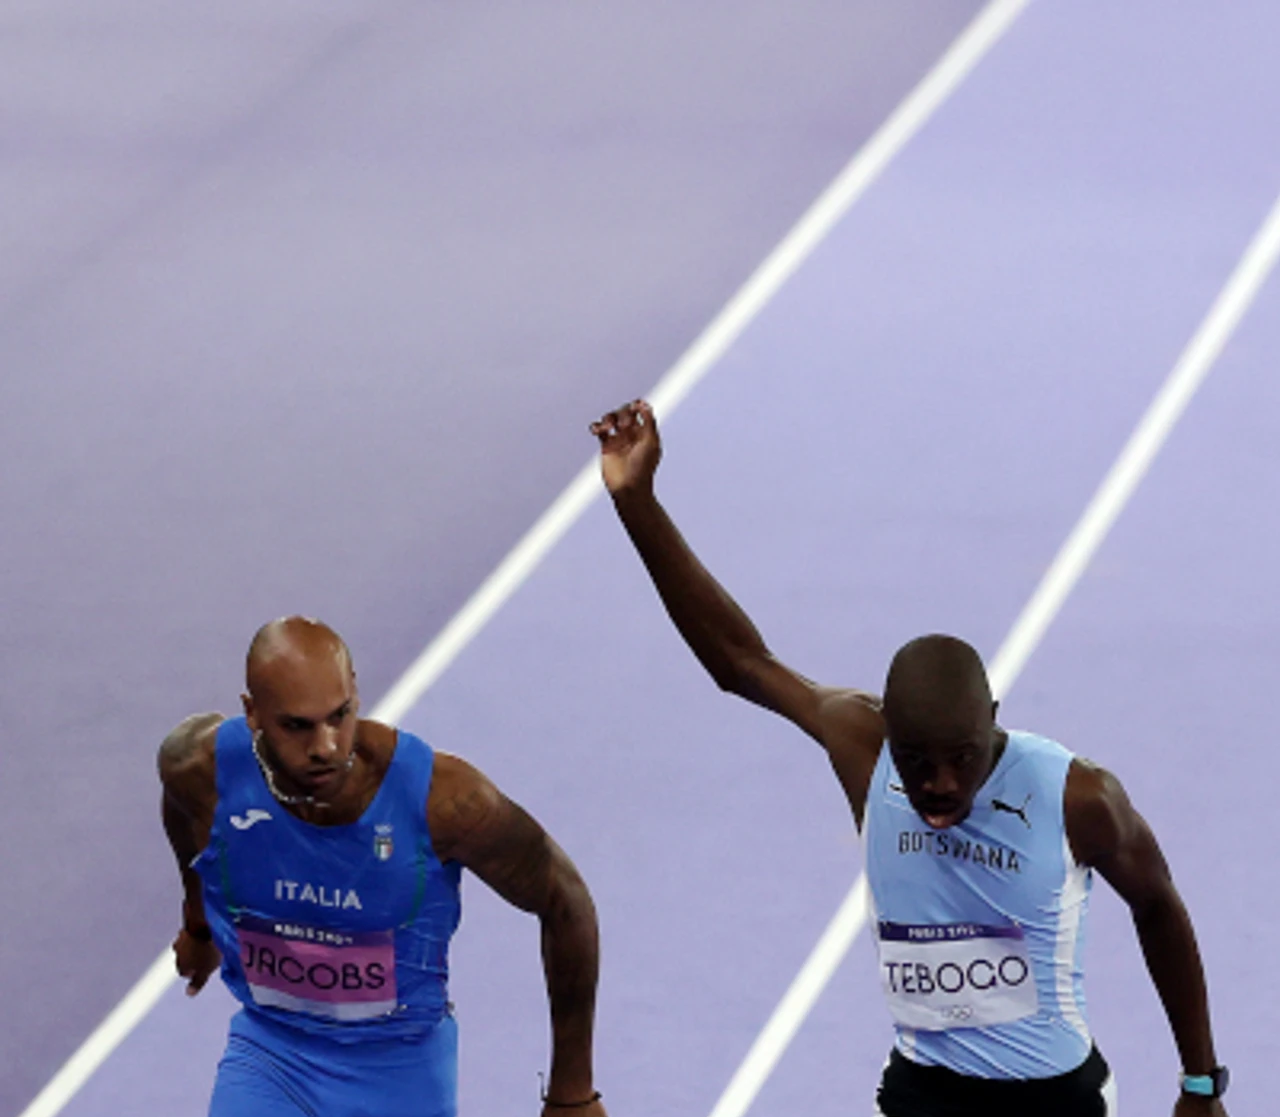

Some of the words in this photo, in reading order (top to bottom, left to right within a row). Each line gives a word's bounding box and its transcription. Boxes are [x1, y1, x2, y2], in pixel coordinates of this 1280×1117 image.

[897, 831, 1022, 874] BOTSWANA
[274, 879, 363, 911] ITALIA
[243, 941, 386, 991] JACOBS
[883, 956, 1028, 995] TEBOGO
